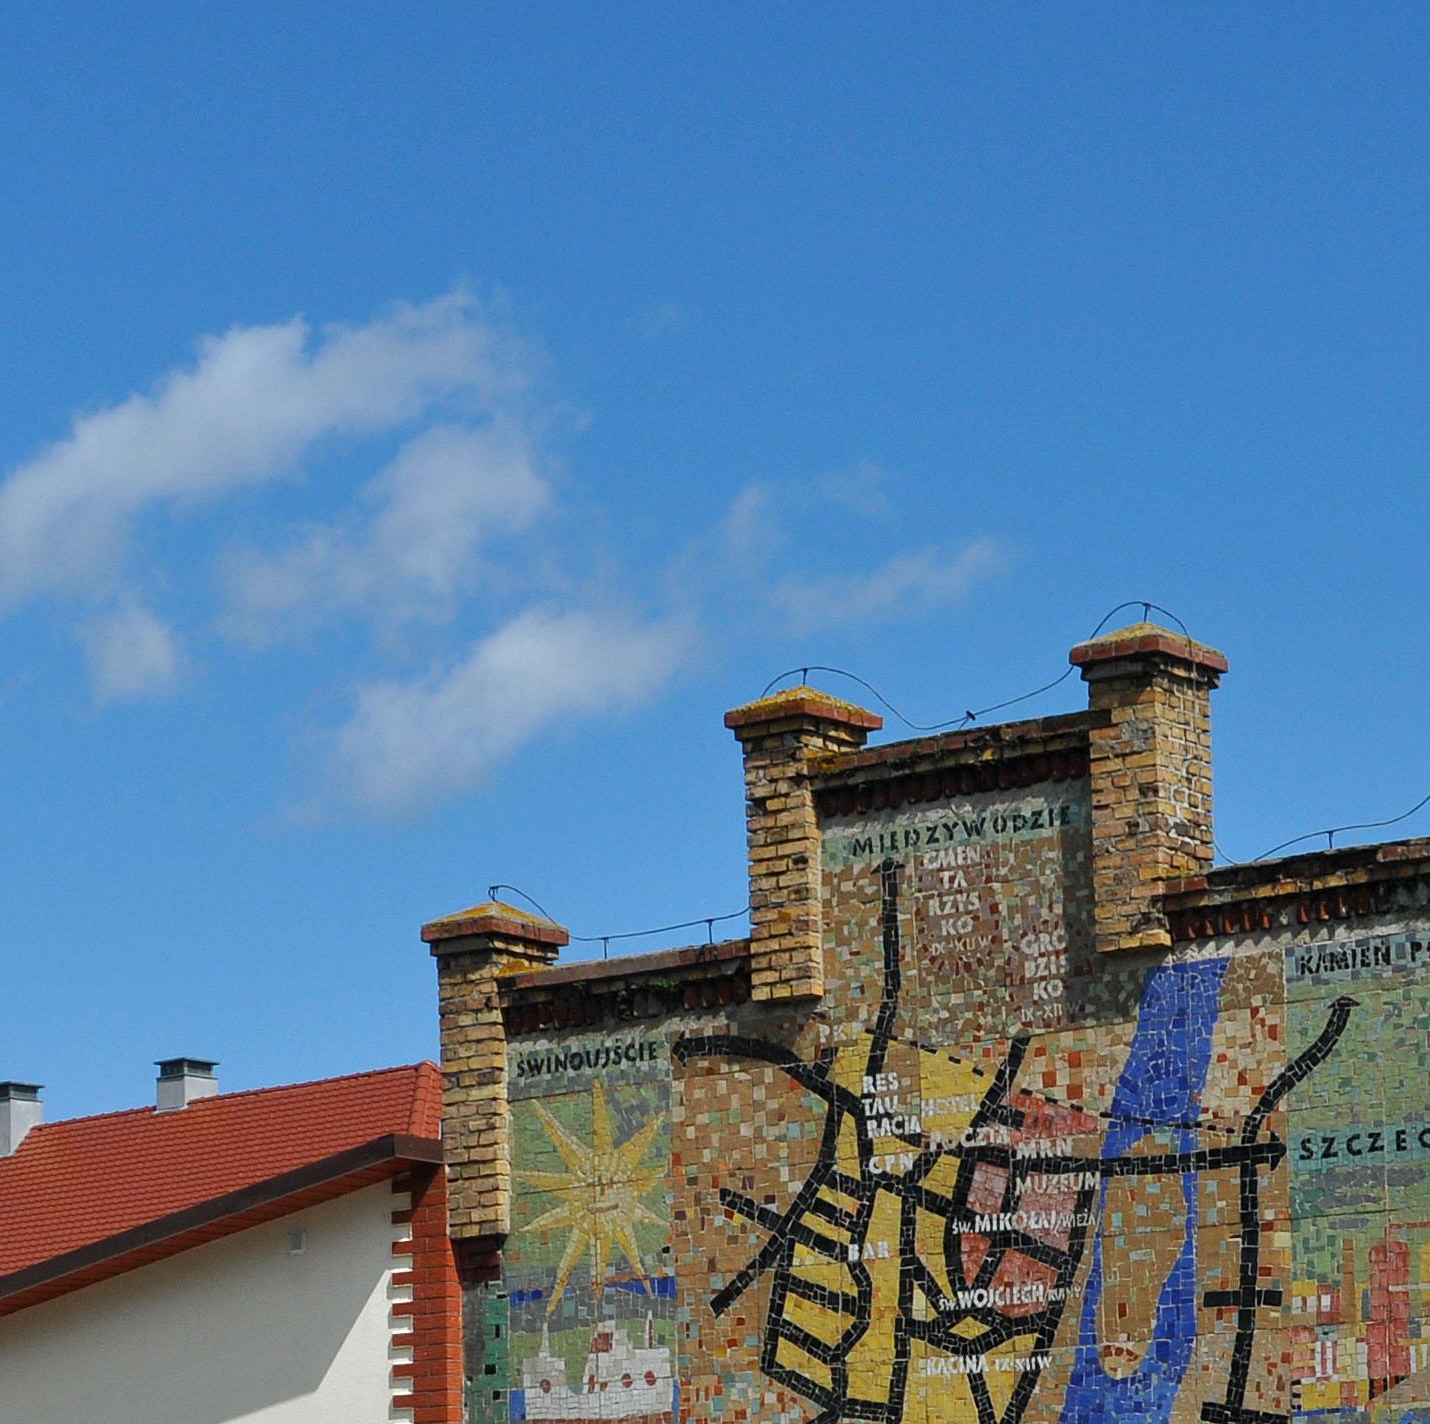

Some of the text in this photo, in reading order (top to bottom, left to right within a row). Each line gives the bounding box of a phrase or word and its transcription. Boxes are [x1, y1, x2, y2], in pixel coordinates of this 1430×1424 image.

[939, 869, 968, 889] TA
[940, 914, 974, 936] KO
[1033, 978, 1064, 1001] KO
[862, 1071, 899, 1094] RES
[862, 1095, 899, 1116] TAU
[1016, 1137, 1074, 1160] MRN
[1015, 1170, 1101, 1196] MUZEUM
[847, 1241, 890, 1262] BAR
